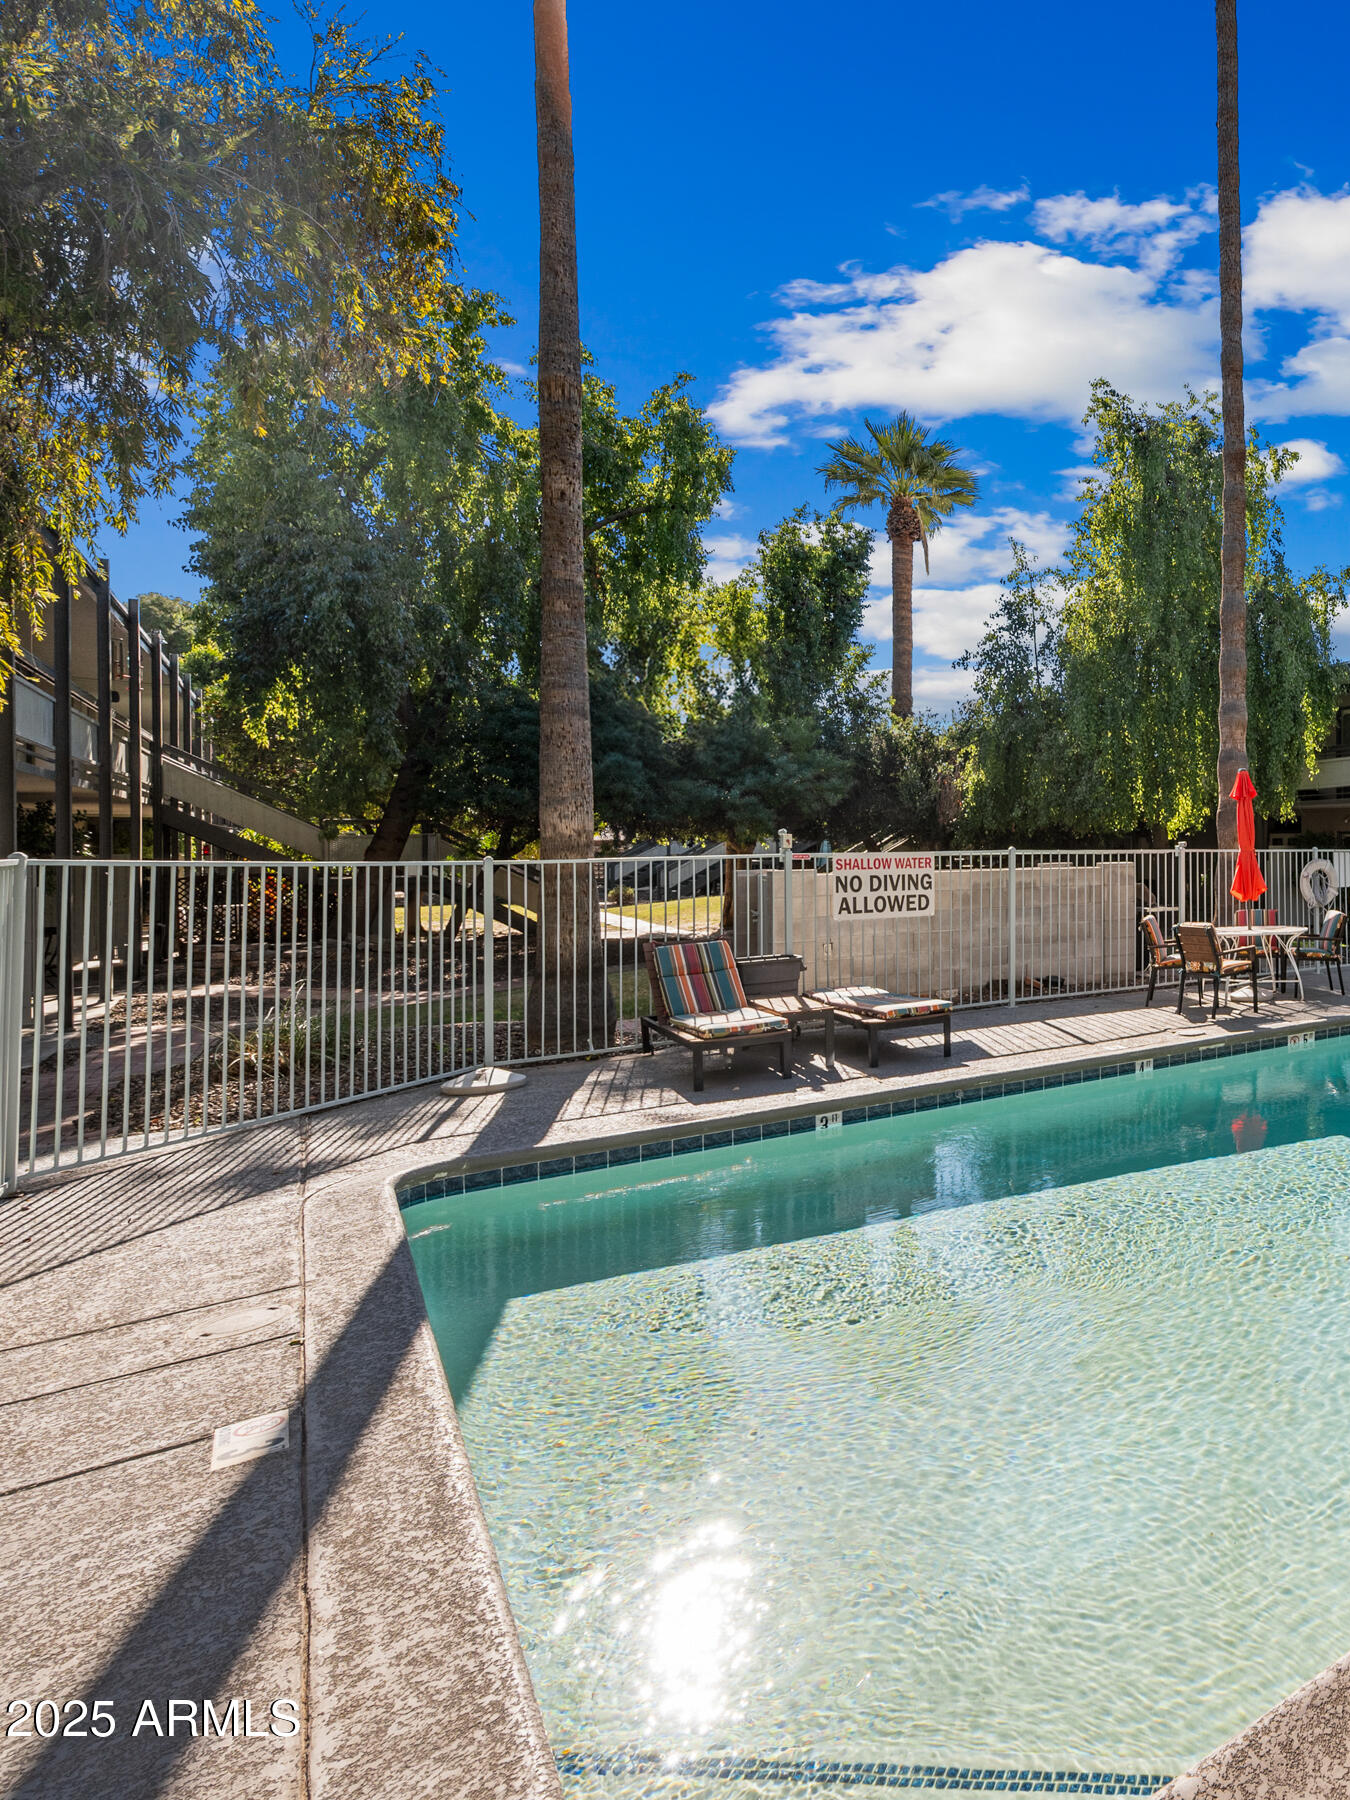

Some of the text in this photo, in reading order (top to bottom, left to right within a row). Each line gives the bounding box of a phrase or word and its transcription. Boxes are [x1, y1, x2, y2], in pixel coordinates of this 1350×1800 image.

[835, 857, 932, 871] SHALLOW WATER
[835, 873, 933, 893] NO DIVING
[838, 894, 930, 915] ALLOWED
